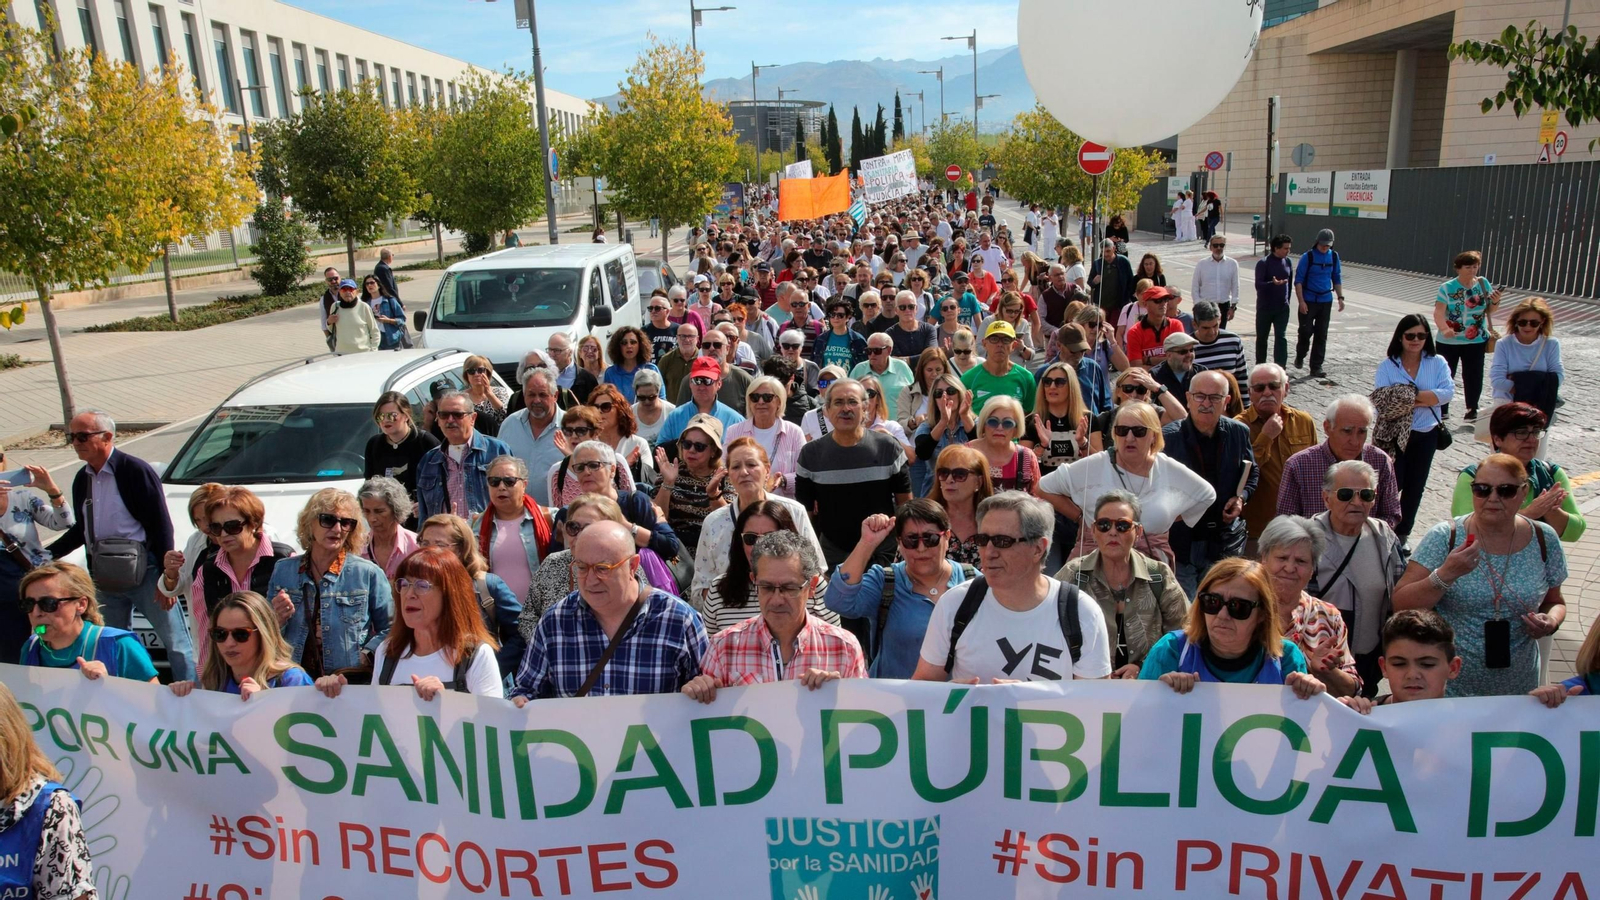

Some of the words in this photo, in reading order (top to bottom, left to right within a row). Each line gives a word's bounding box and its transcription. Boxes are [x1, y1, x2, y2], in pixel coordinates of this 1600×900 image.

[1556, 139, 1564, 148] 20
[862, 158, 887, 171] CONTRA
[867, 165, 899, 178] SANITARIA
[1351, 172, 1371, 181] ENTRADA
[1298, 186, 1314, 194] Consultas
[1313, 186, 1329, 194] Externas
[1344, 182, 1361, 190] Consultas
[1361, 182, 1378, 190] Externas
[872, 188, 904, 201] JUDICIAL
[1346, 191, 1374, 202] URGENCIAS
[20, 702, 121, 761] POR
[126, 722, 251, 775] UNA
[274, 712, 779, 820] SANIDAD
[821, 689, 1418, 833] PÚBLICA
[766, 815, 941, 849] JUSTICIA
[209, 815, 320, 866] #Sin
[338, 821, 680, 897] RECORTES
[804, 855, 822, 872] la
[828, 845, 941, 873] SANIDAD
[991, 828, 1144, 890] #Sin
[0, 886, 29, 899] AD
